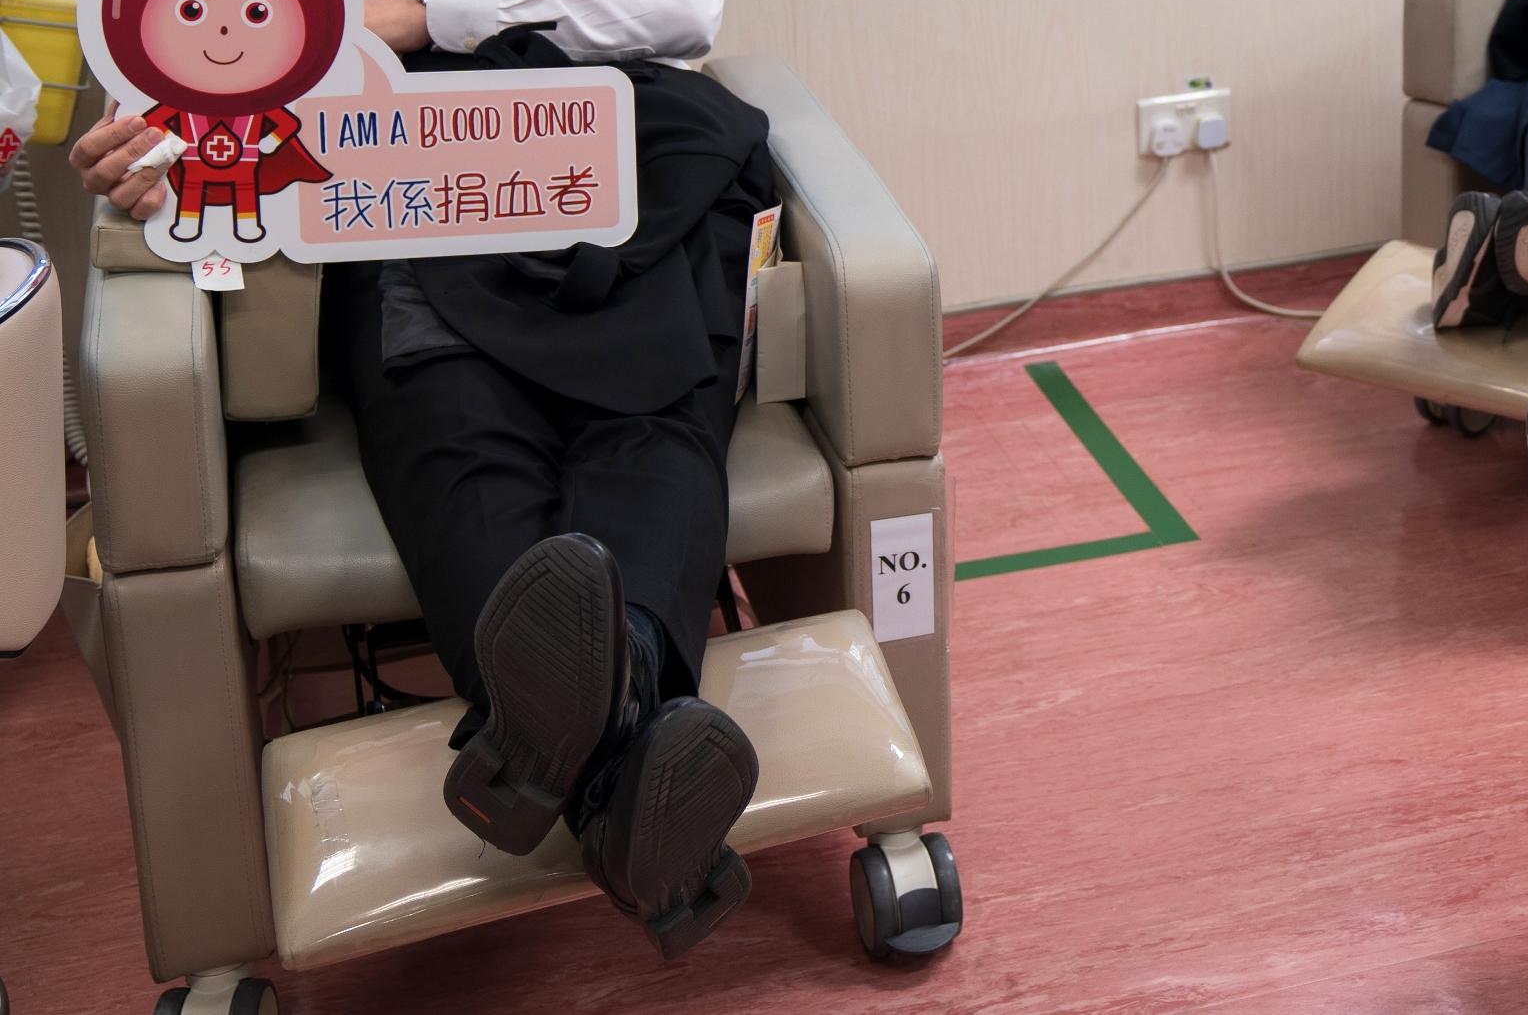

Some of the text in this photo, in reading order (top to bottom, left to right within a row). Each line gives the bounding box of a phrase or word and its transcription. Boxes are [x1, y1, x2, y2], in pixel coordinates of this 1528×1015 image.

[319, 111, 326, 154] I
[339, 112, 378, 148] AM
[390, 110, 408, 146] A
[321, 166, 599, 232] 我係捐血者
[877, 550, 927, 575] NO.
[896, 582, 911, 604] 6
